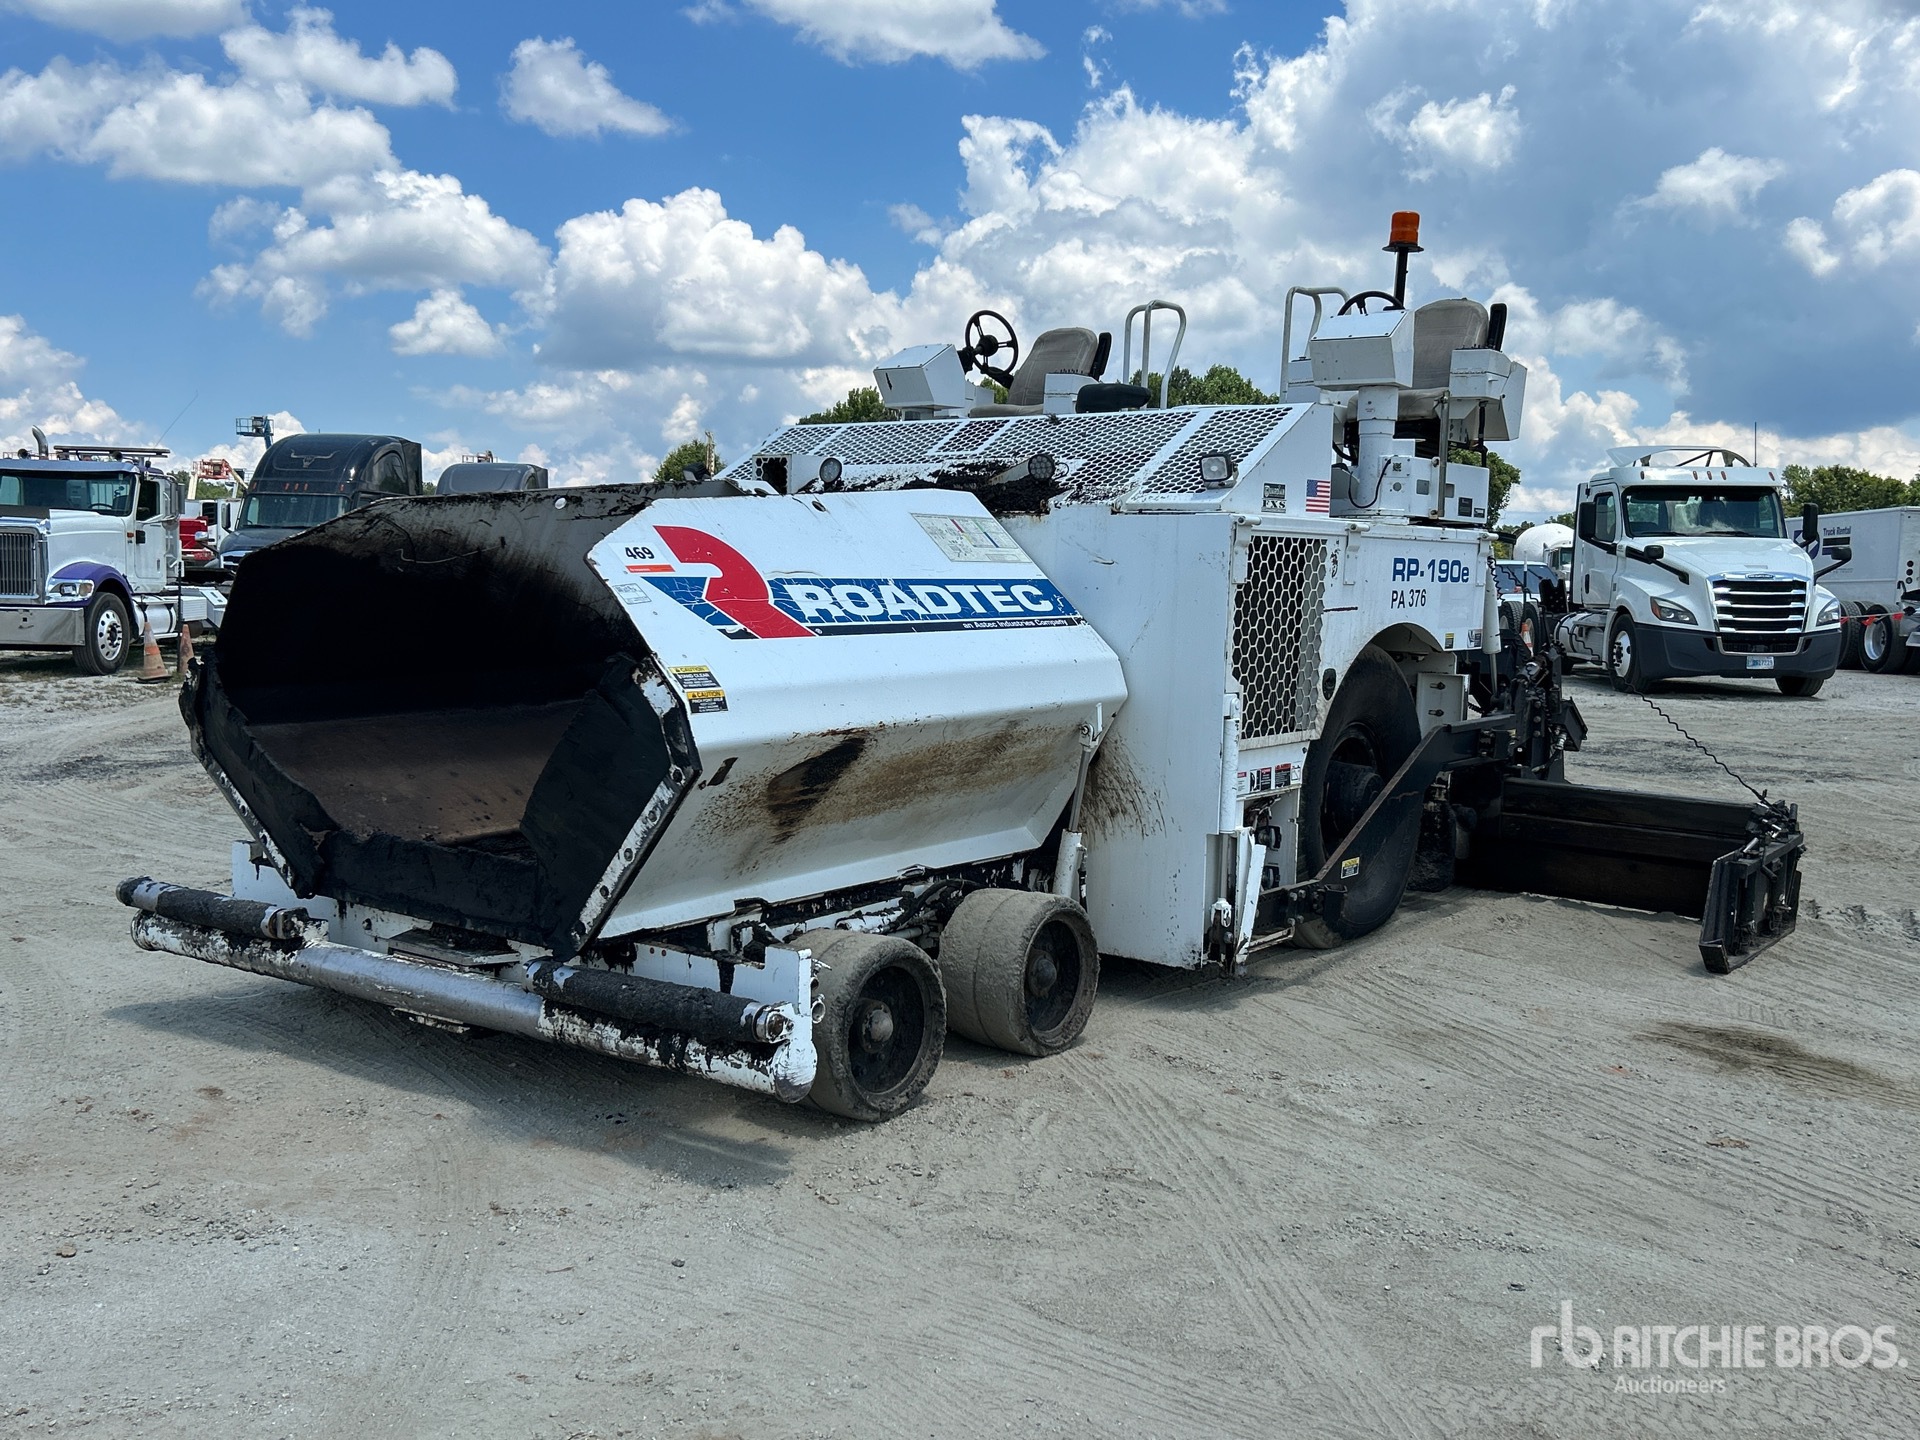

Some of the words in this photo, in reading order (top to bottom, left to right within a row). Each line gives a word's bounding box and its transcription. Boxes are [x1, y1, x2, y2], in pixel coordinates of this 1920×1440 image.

[1823, 527, 1836, 536] Truck
[1836, 526, 1851, 535] Rental
[625, 546, 655, 560] 469
[781, 584, 1054, 618] ROADTEC
[1390, 590, 1406, 609] PA
[1408, 588, 1427, 608] 376
[997, 620, 1036, 628] Industries
[1035, 619, 1069, 627] Company
